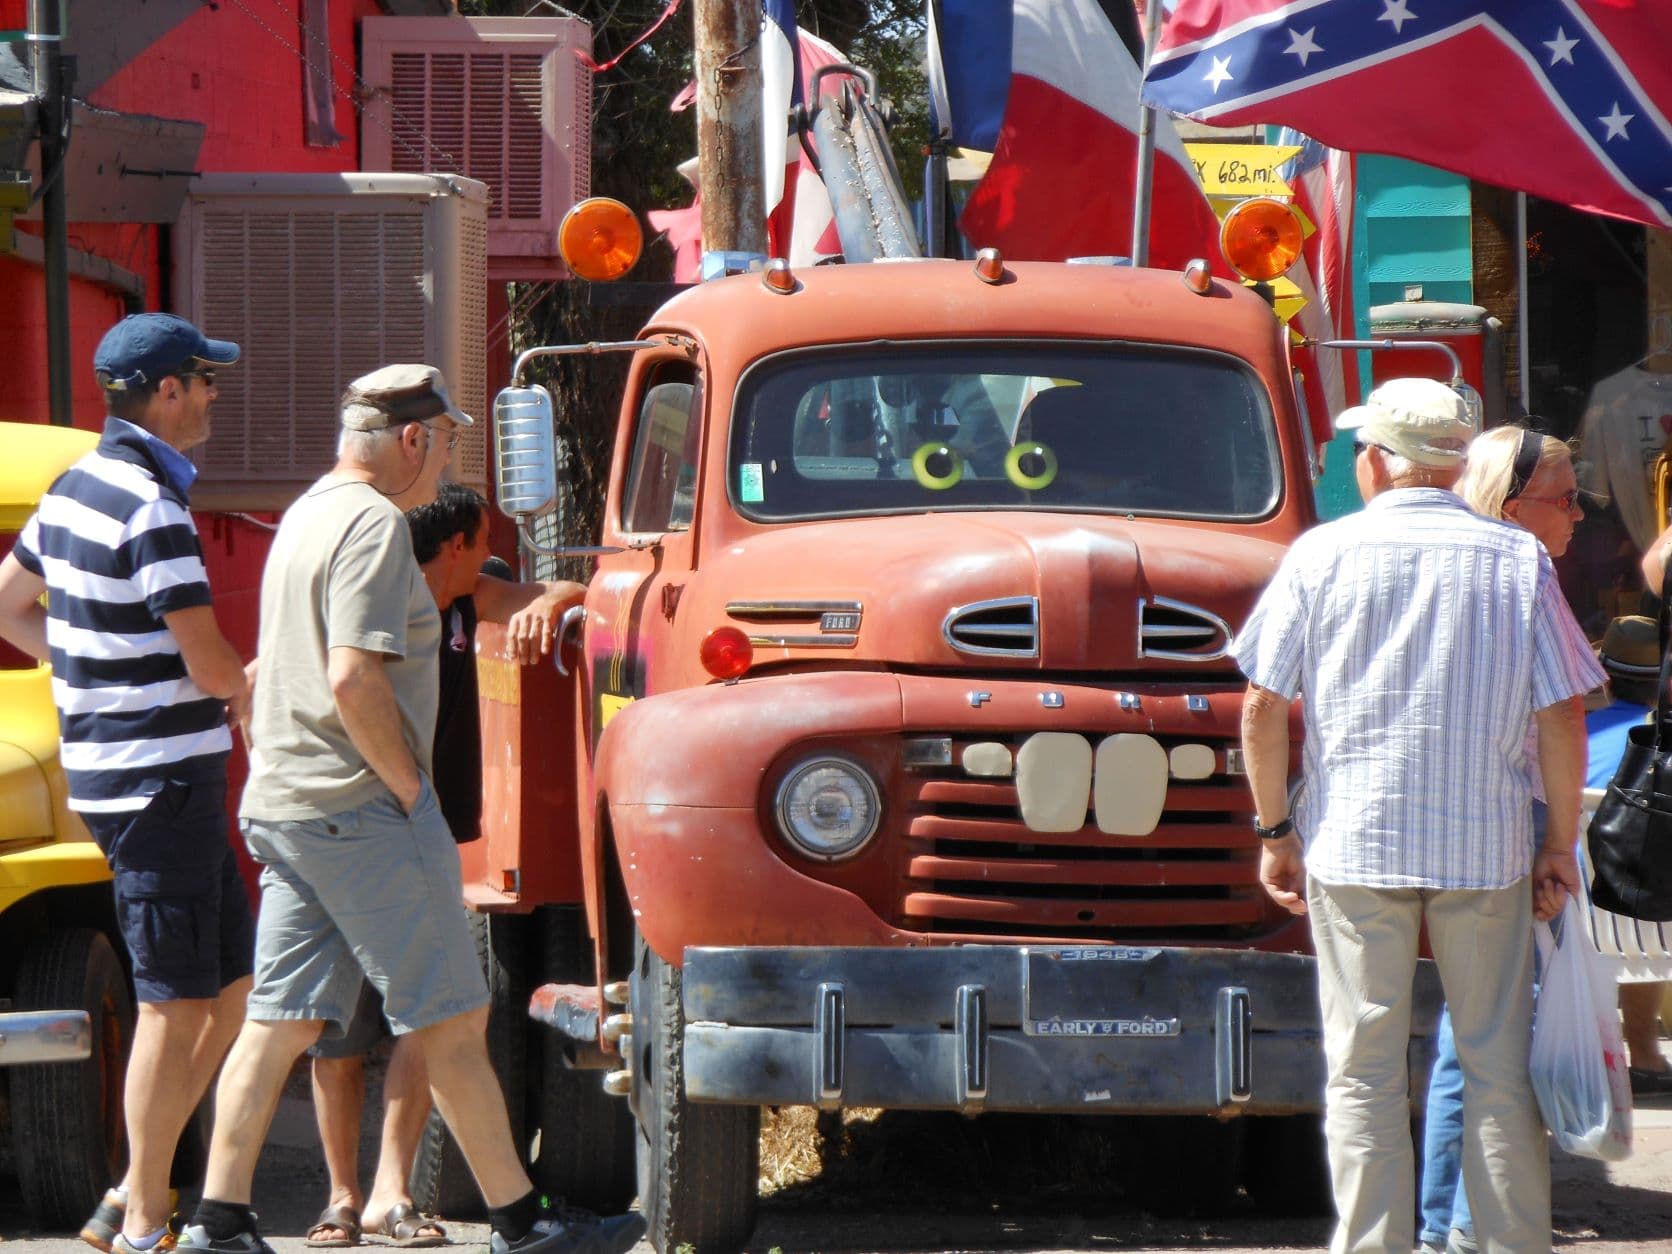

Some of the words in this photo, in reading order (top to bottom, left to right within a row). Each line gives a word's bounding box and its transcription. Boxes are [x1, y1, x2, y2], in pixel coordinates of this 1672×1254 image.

[1218, 160, 1252, 184] 682
[1252, 164, 1276, 184] mi.
[825, 615, 852, 629] FORD
[966, 690, 1210, 712] FORD
[1037, 1022, 1097, 1034] EARLY
[1117, 1022, 1168, 1034] FORD
